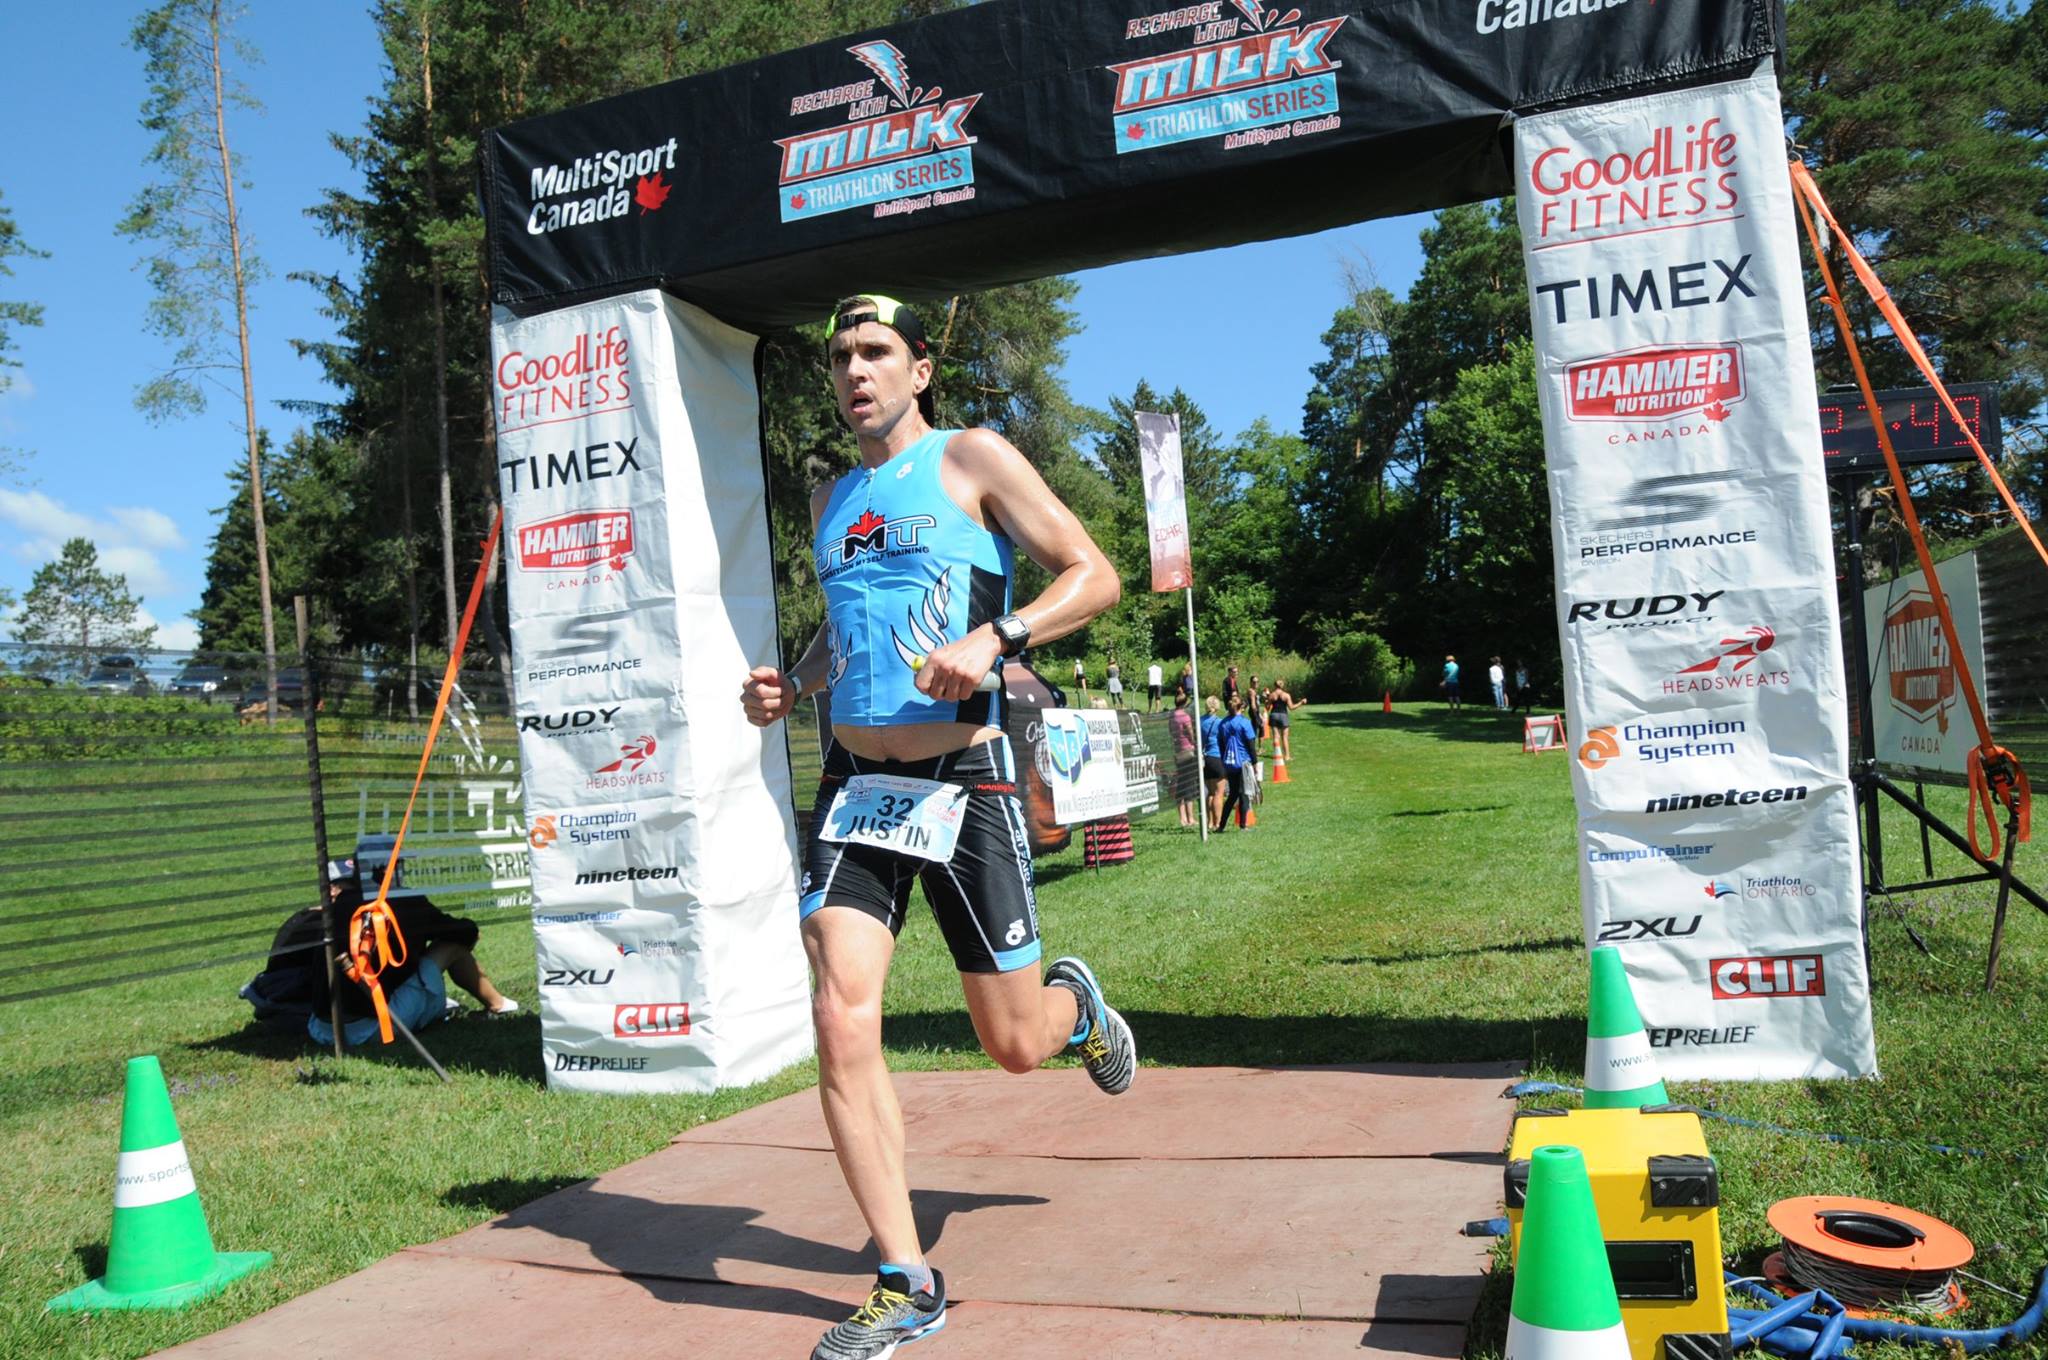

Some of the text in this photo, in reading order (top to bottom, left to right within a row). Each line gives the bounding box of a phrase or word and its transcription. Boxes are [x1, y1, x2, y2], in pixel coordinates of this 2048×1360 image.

[1126, 1, 1222, 39] RECHARGE
[1194, 18, 1239, 44] WITH
[1476, 0, 1628, 34] Cana
[1121, 25, 1332, 106] MILK
[790, 79, 875, 116] RECHARGE
[848, 95, 888, 120] WITH
[786, 103, 968, 178] MILK
[1225, 115, 1341, 149] MultiSport Canada
[530, 136, 678, 202] MultiSport
[1531, 117, 1738, 196] GoodLife
[527, 186, 630, 236] Canada
[874, 186, 976, 218] MultiSport Canada
[1540, 171, 1739, 238] FITNESS
[1536, 253, 1757, 325] TIMEX
[498, 325, 629, 391] GoodLife
[1576, 352, 1733, 401] HAMMER
[502, 370, 631, 424] FITNESS
[1613, 387, 1706, 415] NUTRITION
[1607, 423, 1709, 445] CANADA
[501, 436, 642, 494] TIMEX
[523, 515, 629, 556] HAMMER
[1579, 530, 1654, 546] SKECHERS
[1581, 530, 1757, 558] PERFORMANCE
[550, 545, 612, 567] NUTRITION
[886, 546, 929, 559] TRAINING
[546, 573, 616, 591] CANADA
[1567, 590, 1726, 624] RUDY
[1606, 615, 1718, 630] PROJECT
[528, 658, 642, 682] PERFORMANCE
[1663, 670, 1791, 695] HEADSWEATS
[520, 706, 621, 733] RUDY
[1624, 718, 1746, 744] Champion
[1639, 740, 1736, 764] System
[1901, 736, 1941, 754] CANADA
[586, 772, 667, 790] HEADSWEATS
[877, 794, 915, 822] 32
[1645, 785, 1808, 814] nineteen
[560, 810, 637, 829] Champion
[846, 815, 931, 850] JUSTIN
[570, 829, 630, 846] System
[1588, 844, 1714, 862] CompuTrainer
[575, 866, 679, 886] nineteen
[1746, 876, 1802, 888] Triathlon
[1747, 883, 1818, 899] ONTARIO
[1597, 914, 1703, 942] 2XU
[543, 968, 616, 986] 2XU
[1716, 958, 1818, 994] CLIF
[617, 1006, 686, 1034] CLIF
